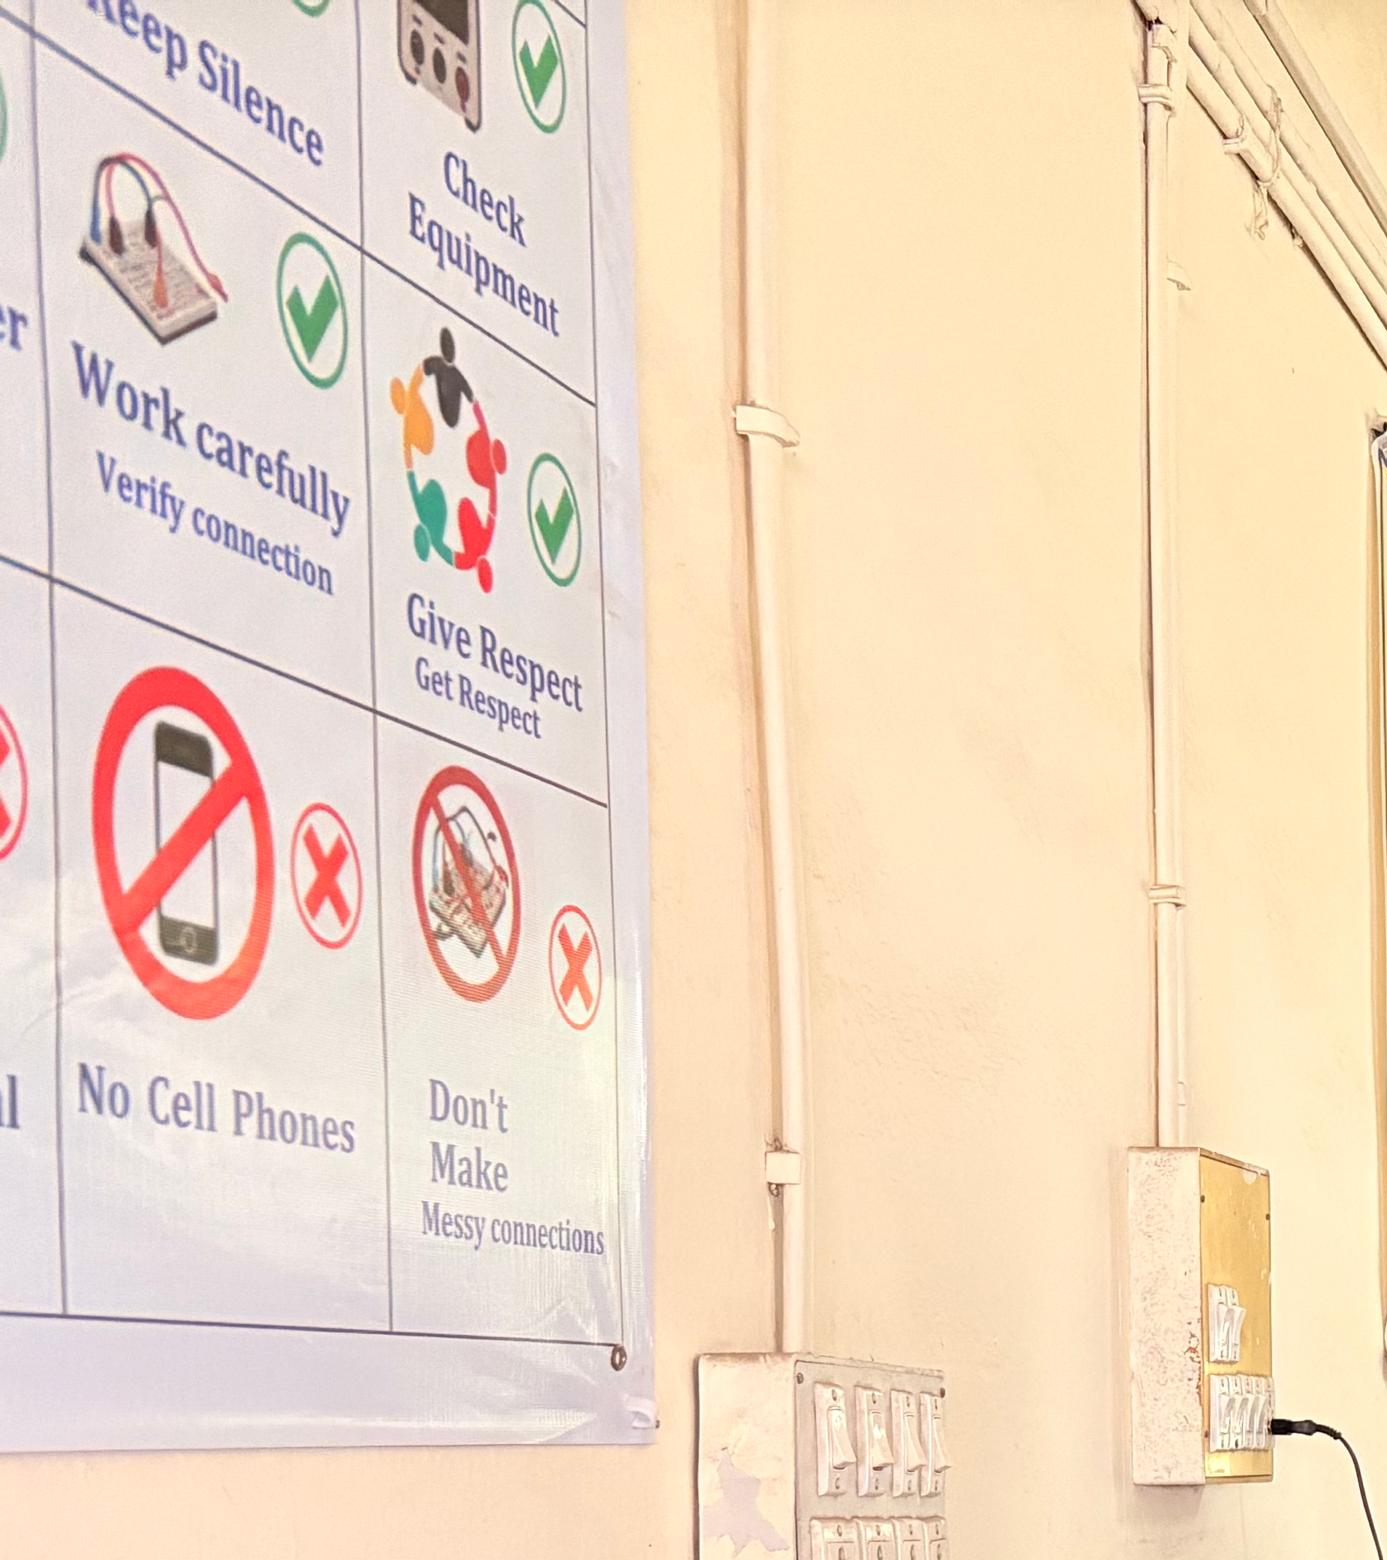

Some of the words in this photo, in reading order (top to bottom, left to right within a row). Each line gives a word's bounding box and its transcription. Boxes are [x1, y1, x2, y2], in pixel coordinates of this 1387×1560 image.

[197, 39, 324, 168] Silence
[443, 151, 527, 248] Check
[407, 191, 560, 338] Equipment
[70, 339, 188, 450] Work
[195, 421, 351, 540] carefully
[95, 449, 186, 535] Verify
[191, 506, 335, 597] connection
[406, 592, 472, 660] Give
[478, 624, 584, 713] Respect
[414, 656, 455, 702] Get
[457, 673, 542, 740] Respect
[77, 1062, 131, 1120] No
[147, 1075, 218, 1133] Cell
[232, 1089, 355, 1154] Phones
[428, 1078, 509, 1134] Don't
[429, 1141, 509, 1193] Make
[421, 1200, 486, 1252] Messy
[490, 1218, 605, 1256] connections
